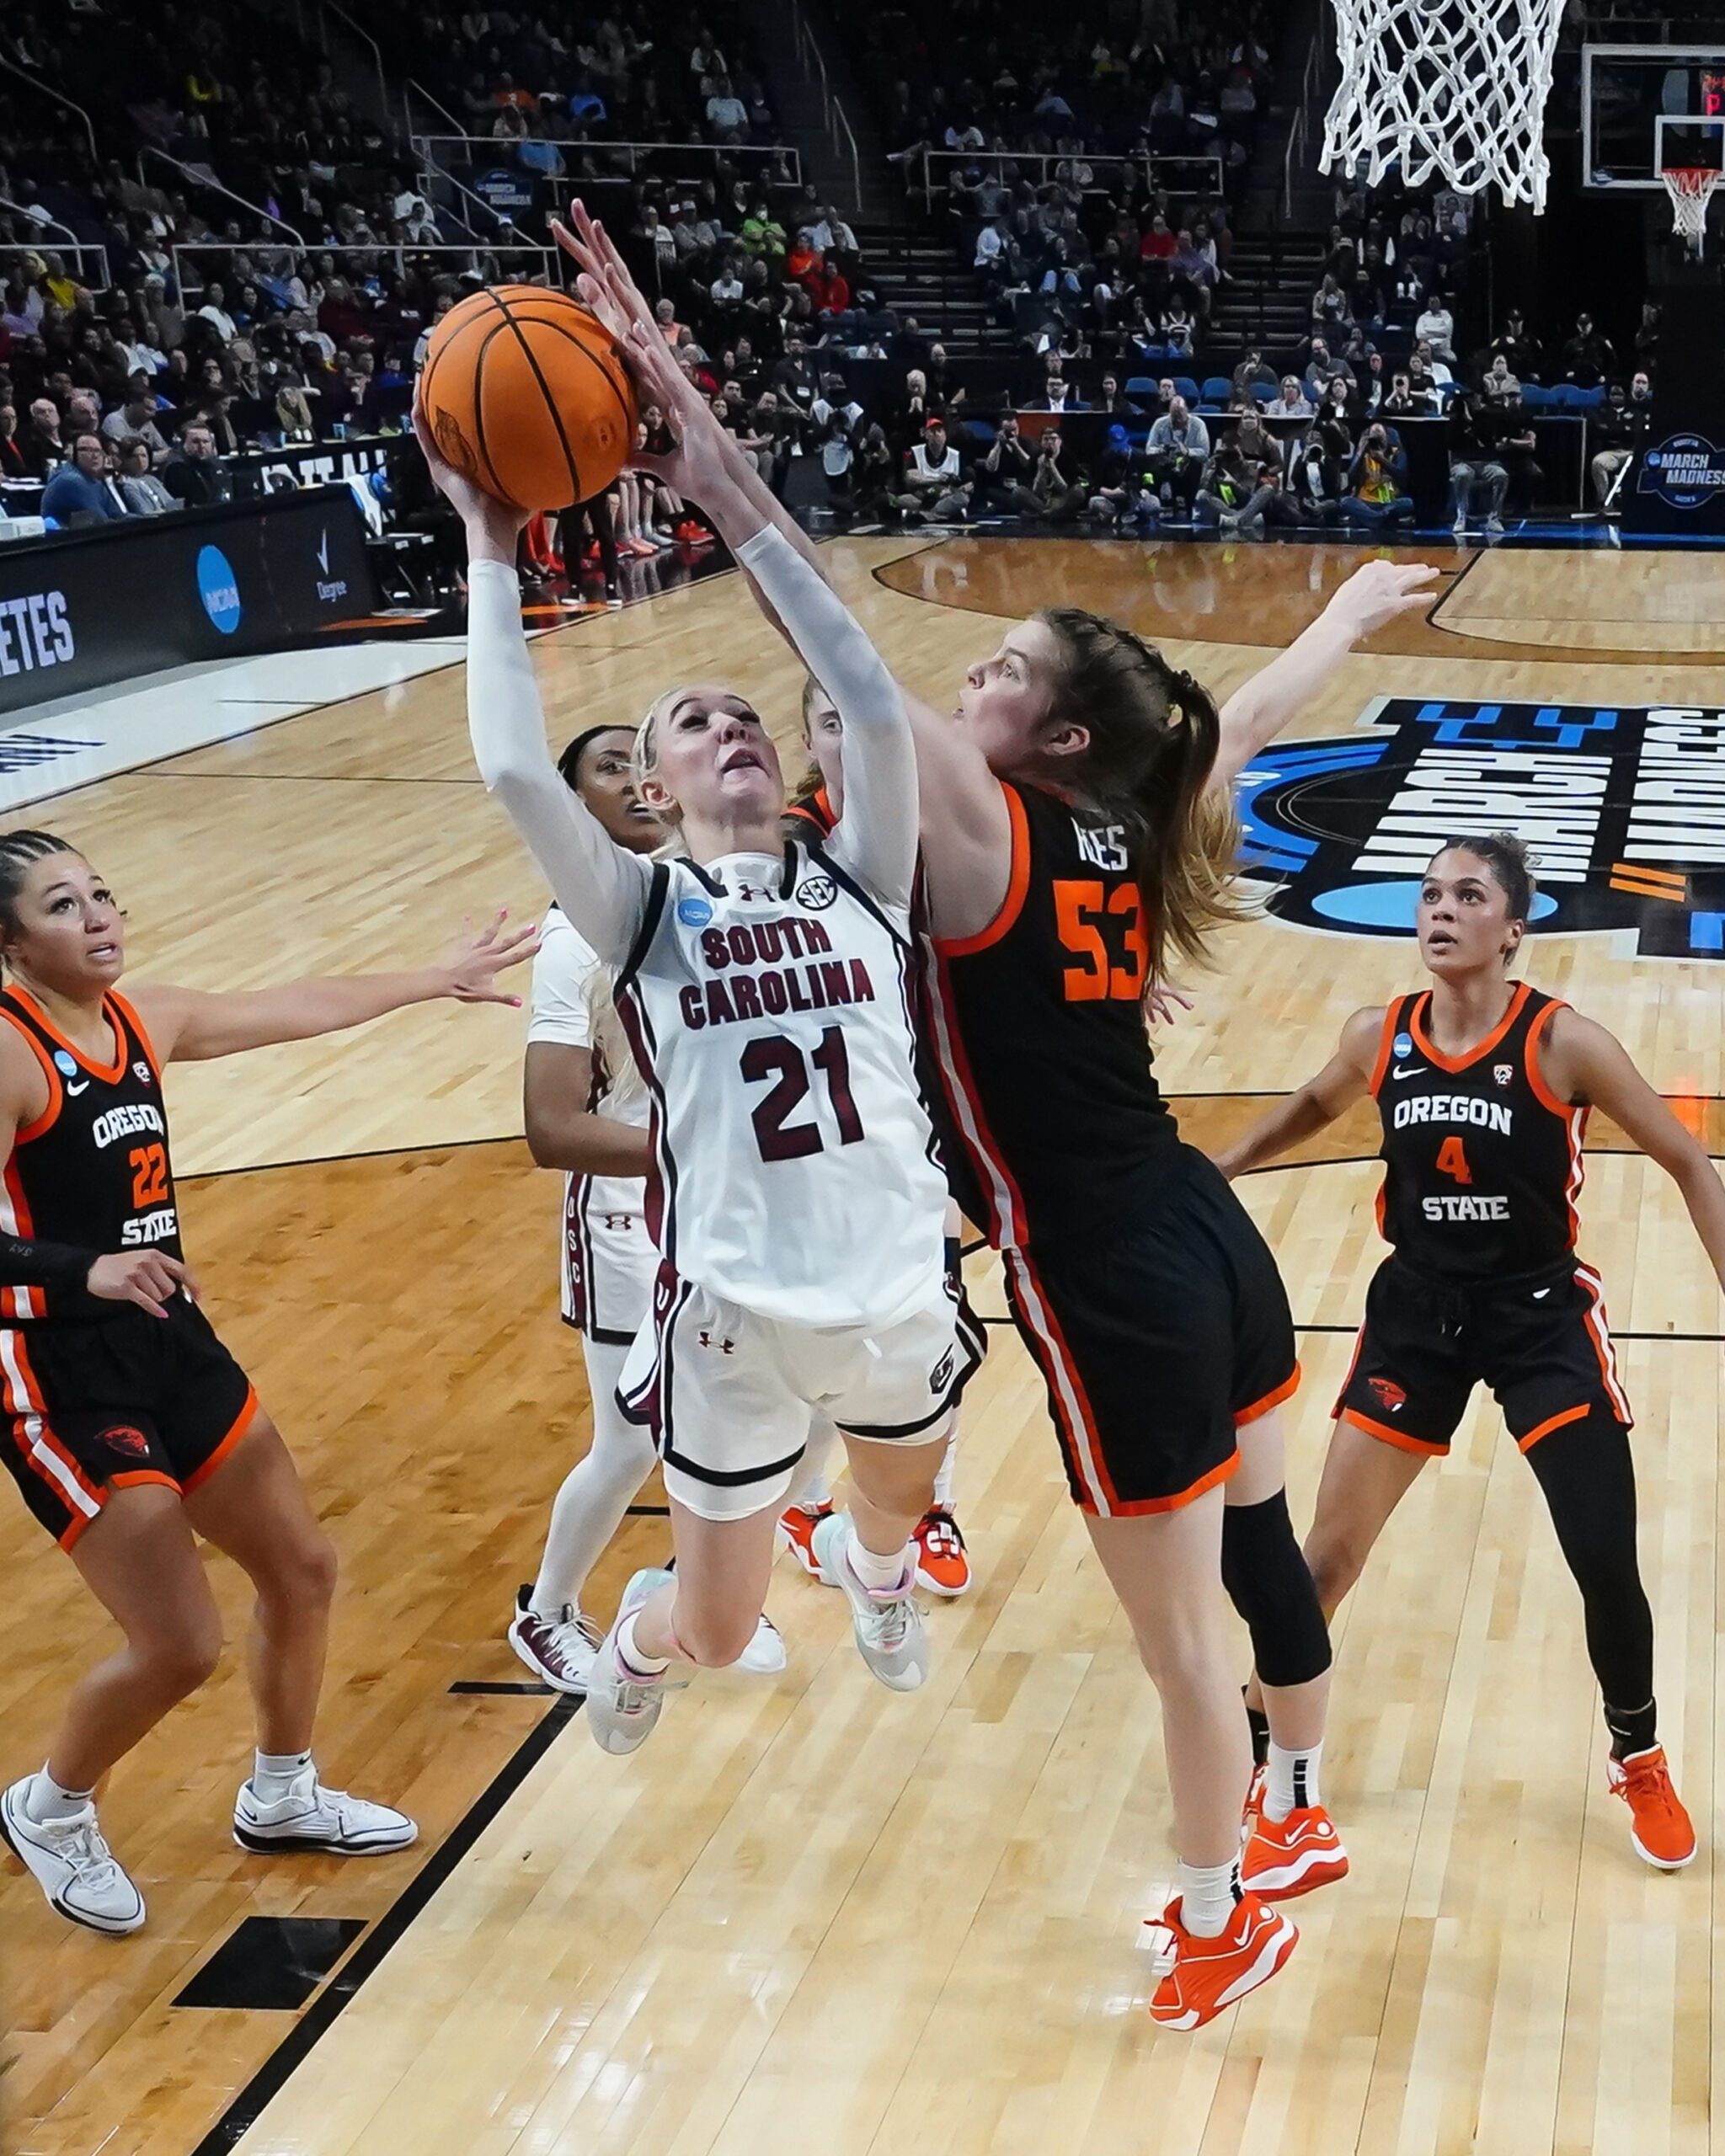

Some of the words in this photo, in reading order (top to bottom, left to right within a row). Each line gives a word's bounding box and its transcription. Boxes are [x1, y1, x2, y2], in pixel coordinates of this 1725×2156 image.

[1660, 453, 1709, 468] MARCH
[701, 916, 832, 969] SOUTH
[1052, 879, 1149, 1000] 53
[679, 958, 876, 1031] CAROLINA
[740, 1025, 866, 1163] 21
[1394, 1095, 1513, 1136] OREGON
[129, 1142, 168, 1209] 22
[1435, 1136, 1473, 1184] 4
[1422, 1195, 1511, 1221] STATE
